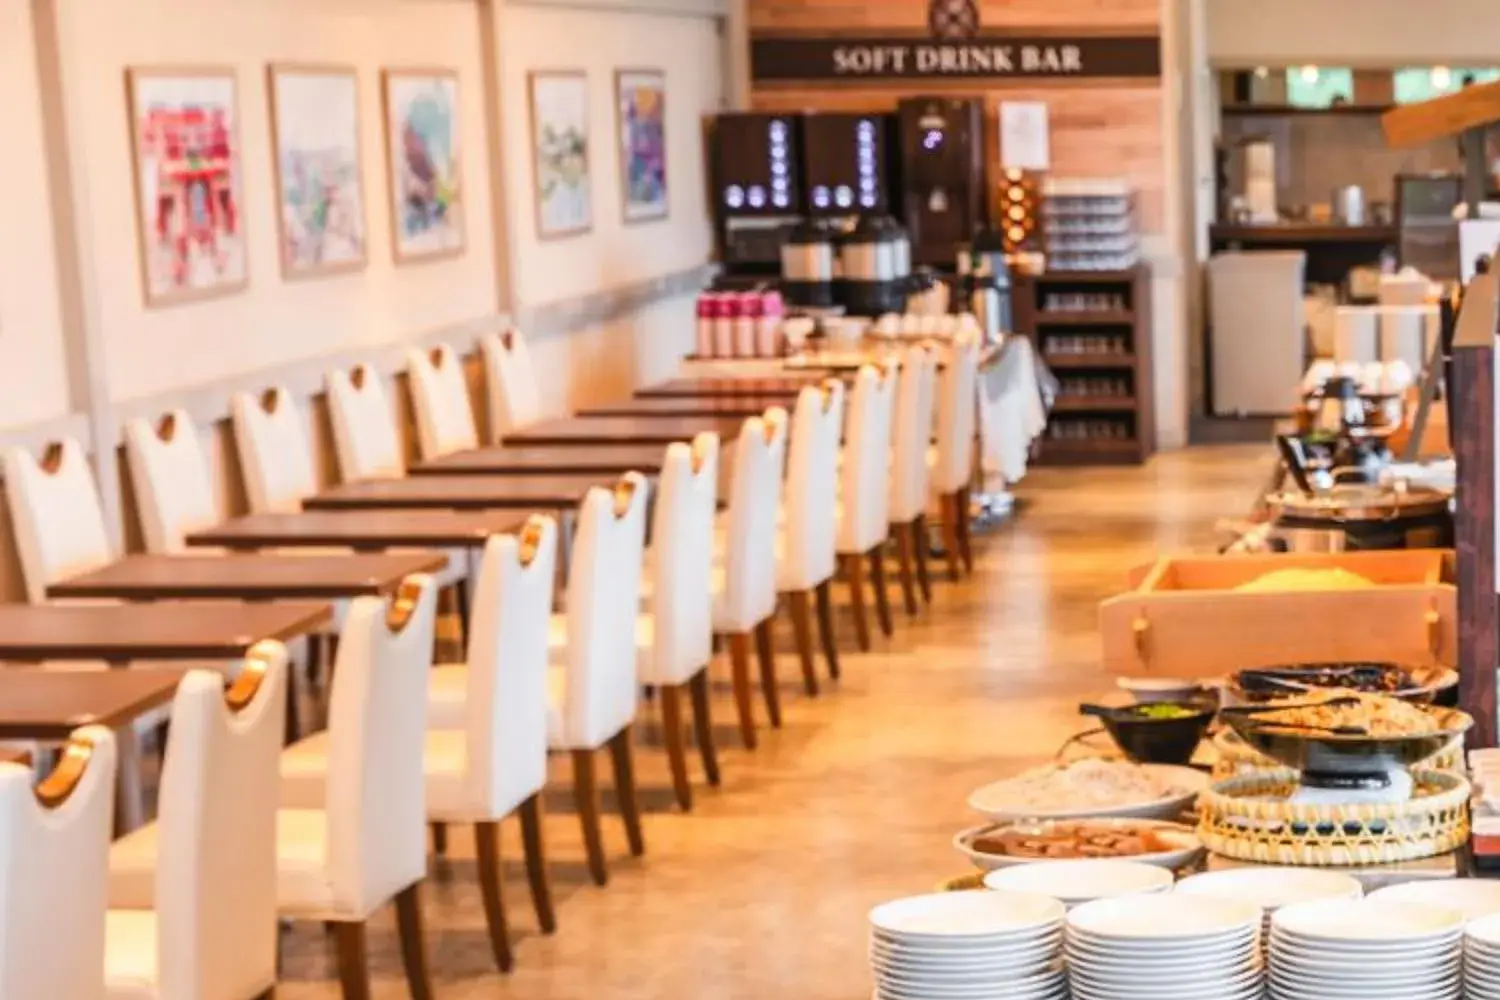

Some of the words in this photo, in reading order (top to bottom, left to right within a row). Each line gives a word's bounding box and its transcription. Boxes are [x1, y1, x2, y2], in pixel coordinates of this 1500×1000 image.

[833, 46, 909, 73] SOFT
[915, 45, 1014, 73] DRINK
[1020, 45, 1083, 72] BAR
